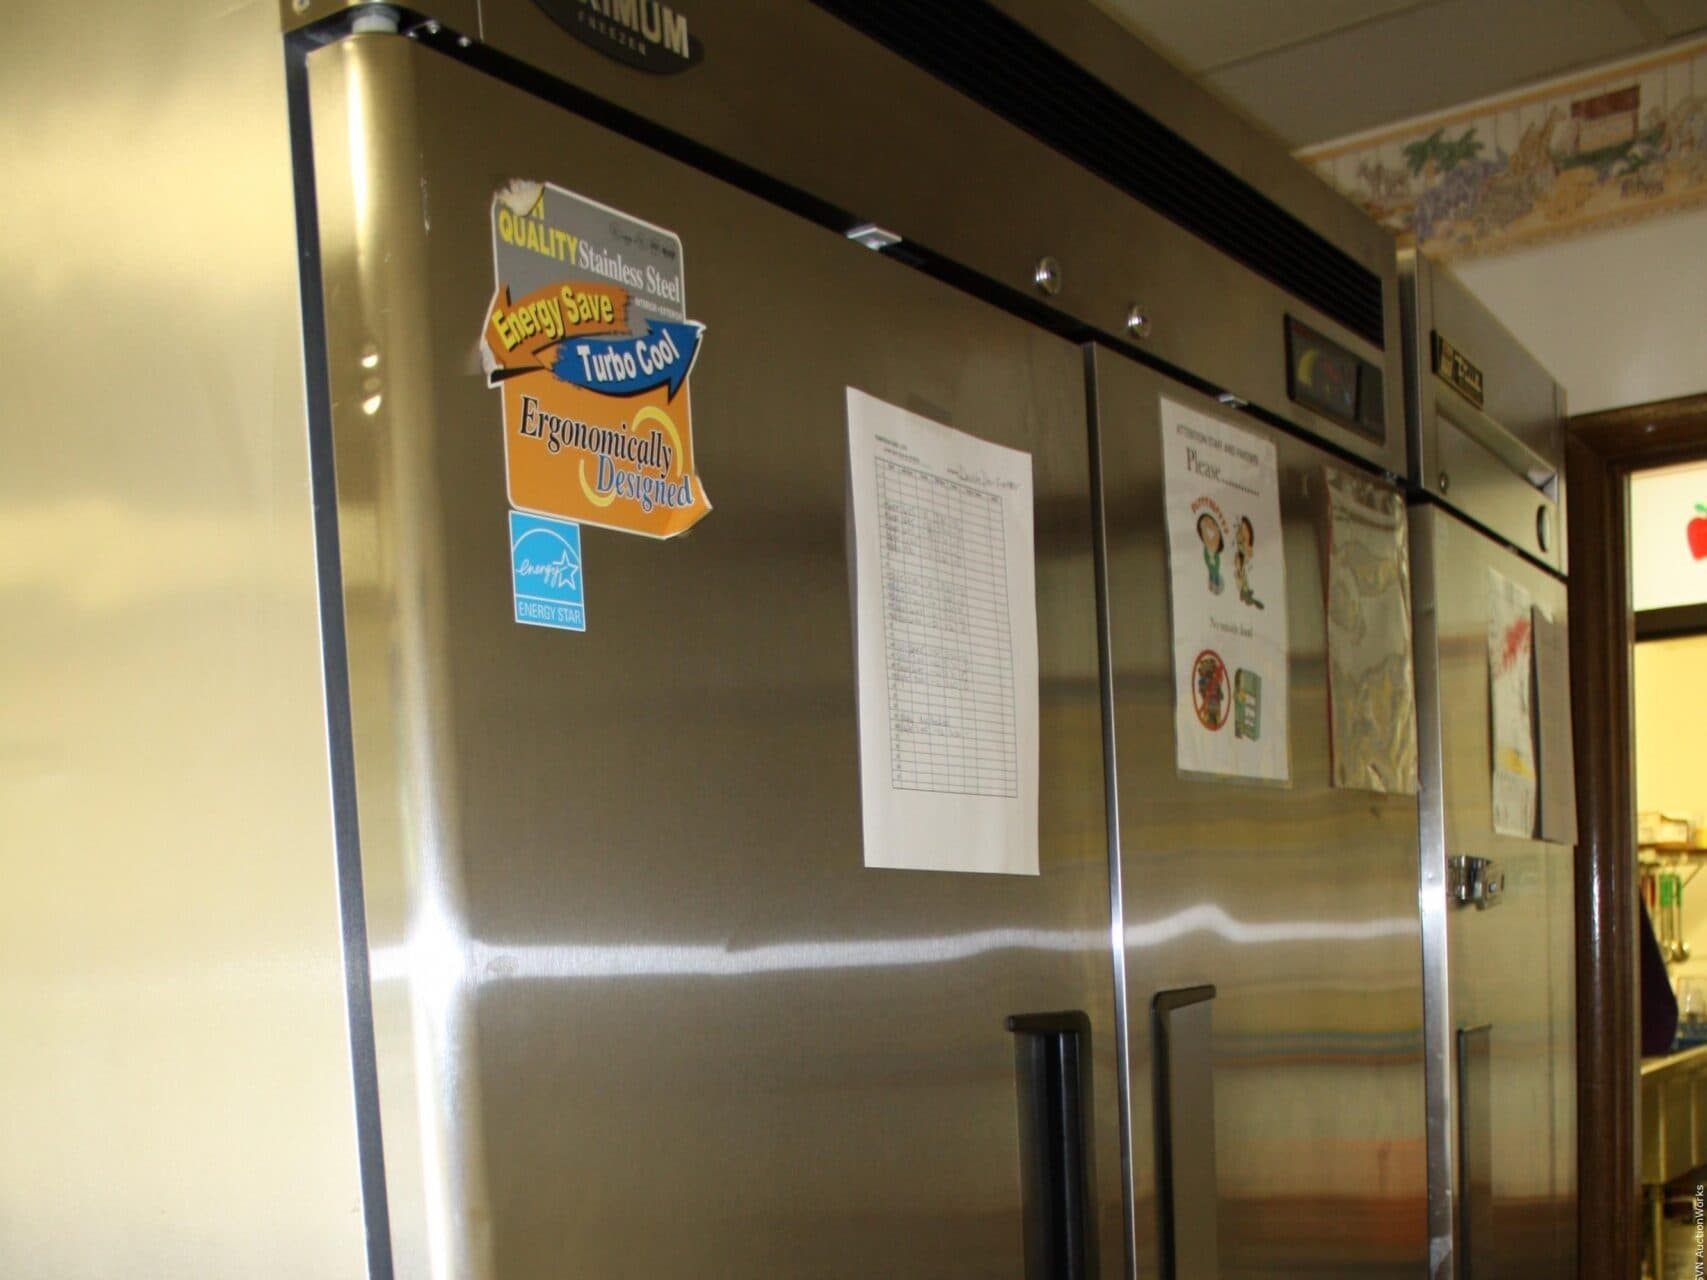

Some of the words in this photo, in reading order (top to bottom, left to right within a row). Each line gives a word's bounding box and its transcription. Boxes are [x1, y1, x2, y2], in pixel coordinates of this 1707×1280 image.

[498, 208, 579, 266] QUALITY
[578, 239, 644, 287] Stainless
[646, 265, 680, 302] Steel
[491, 296, 565, 349] Energy
[561, 285, 615, 324] Save
[576, 345, 636, 382] Turbo
[636, 328, 680, 376] Cool
[520, 396, 673, 479] Ergonomically
[597, 454, 694, 512] Designed
[516, 558, 562, 588] energy
[518, 601, 557, 621] ENERGY
[558, 607, 581, 625] STAR
